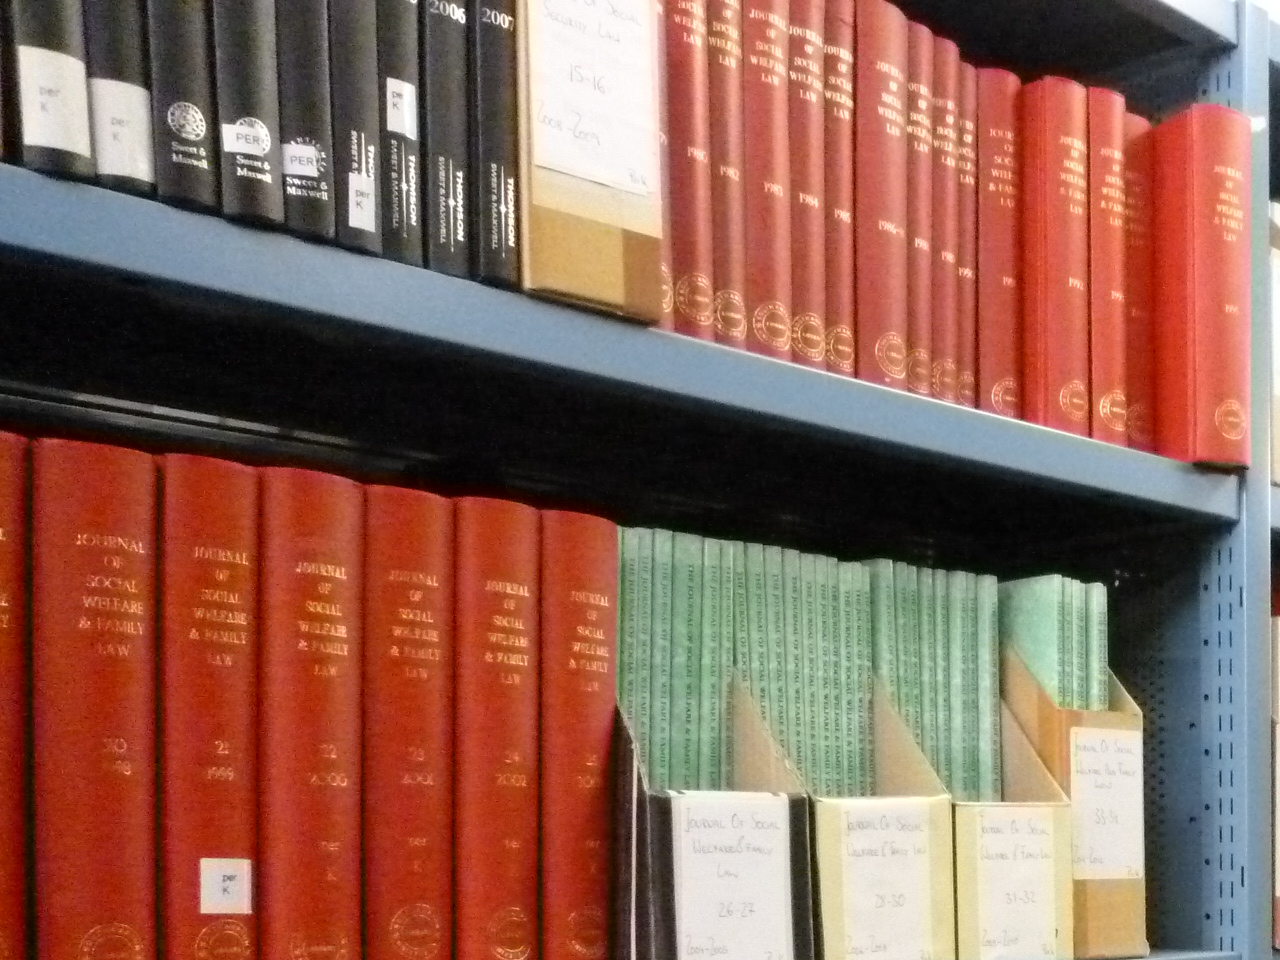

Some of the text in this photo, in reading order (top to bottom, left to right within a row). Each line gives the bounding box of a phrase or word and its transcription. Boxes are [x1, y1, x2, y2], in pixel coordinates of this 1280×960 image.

[430, 0, 466, 24] 2006
[481, 7, 515, 31] 2007
[749, 9, 787, 31] JOURNAL
[683, 32, 702, 47] LAW
[766, 29, 776, 39] OF
[789, 26, 823, 48] JOURNAL
[756, 41, 783, 58] SOCIAL
[804, 44, 814, 54] OF
[719, 55, 736, 68] LAW
[838, 63, 848, 73] OF
[761, 73, 779, 86] LAW
[39, 86, 61, 98] per
[800, 89, 817, 103] LAW
[40, 103, 48, 113] K
[392, 102, 400, 111] K
[834, 107, 850, 121] LAW
[113, 132, 120, 142] K
[236, 132, 260, 145] PER
[171, 141, 206, 156] Sweet &
[172, 153, 208, 169] Maxwell
[236, 155, 271, 171] Sweet &
[290, 155, 314, 167] PER
[237, 166, 272, 183] Maxwell
[438, 156, 446, 187] SWEET
[490, 162, 498, 194] SWEET
[286, 176, 328, 190] Sweet &
[408, 155, 417, 226] THOMSON
[286, 186, 328, 200] Maxwell
[356, 190, 370, 199] per
[799, 192, 819, 209] 1984
[356, 200, 363, 210] K
[456, 170, 464, 242] THOMSON
[507, 177, 515, 247] THOMSON
[75, 533, 145, 554] JOURNAL
[194, 546, 249, 565] JOURNAL
[296, 561, 347, 580] JOURNAL
[86, 575, 139, 593] SOCIAL
[485, 580, 530, 597] JOURNAL
[82, 596, 144, 614] WELFARE
[571, 590, 609, 607] JOURNAL
[194, 607, 248, 625] WELFARE
[492, 615, 525, 630] SOCIAL
[97, 618, 145, 635] FAMILY
[576, 625, 605, 639] SOCIAL
[203, 631, 248, 644] FAMILY
[496, 652, 529, 666] FAMILY
[222, 873, 237, 884] per
[222, 886, 230, 896] K
[1006, 890, 1036, 906] 31-32
[718, 901, 755, 917] 26-27
